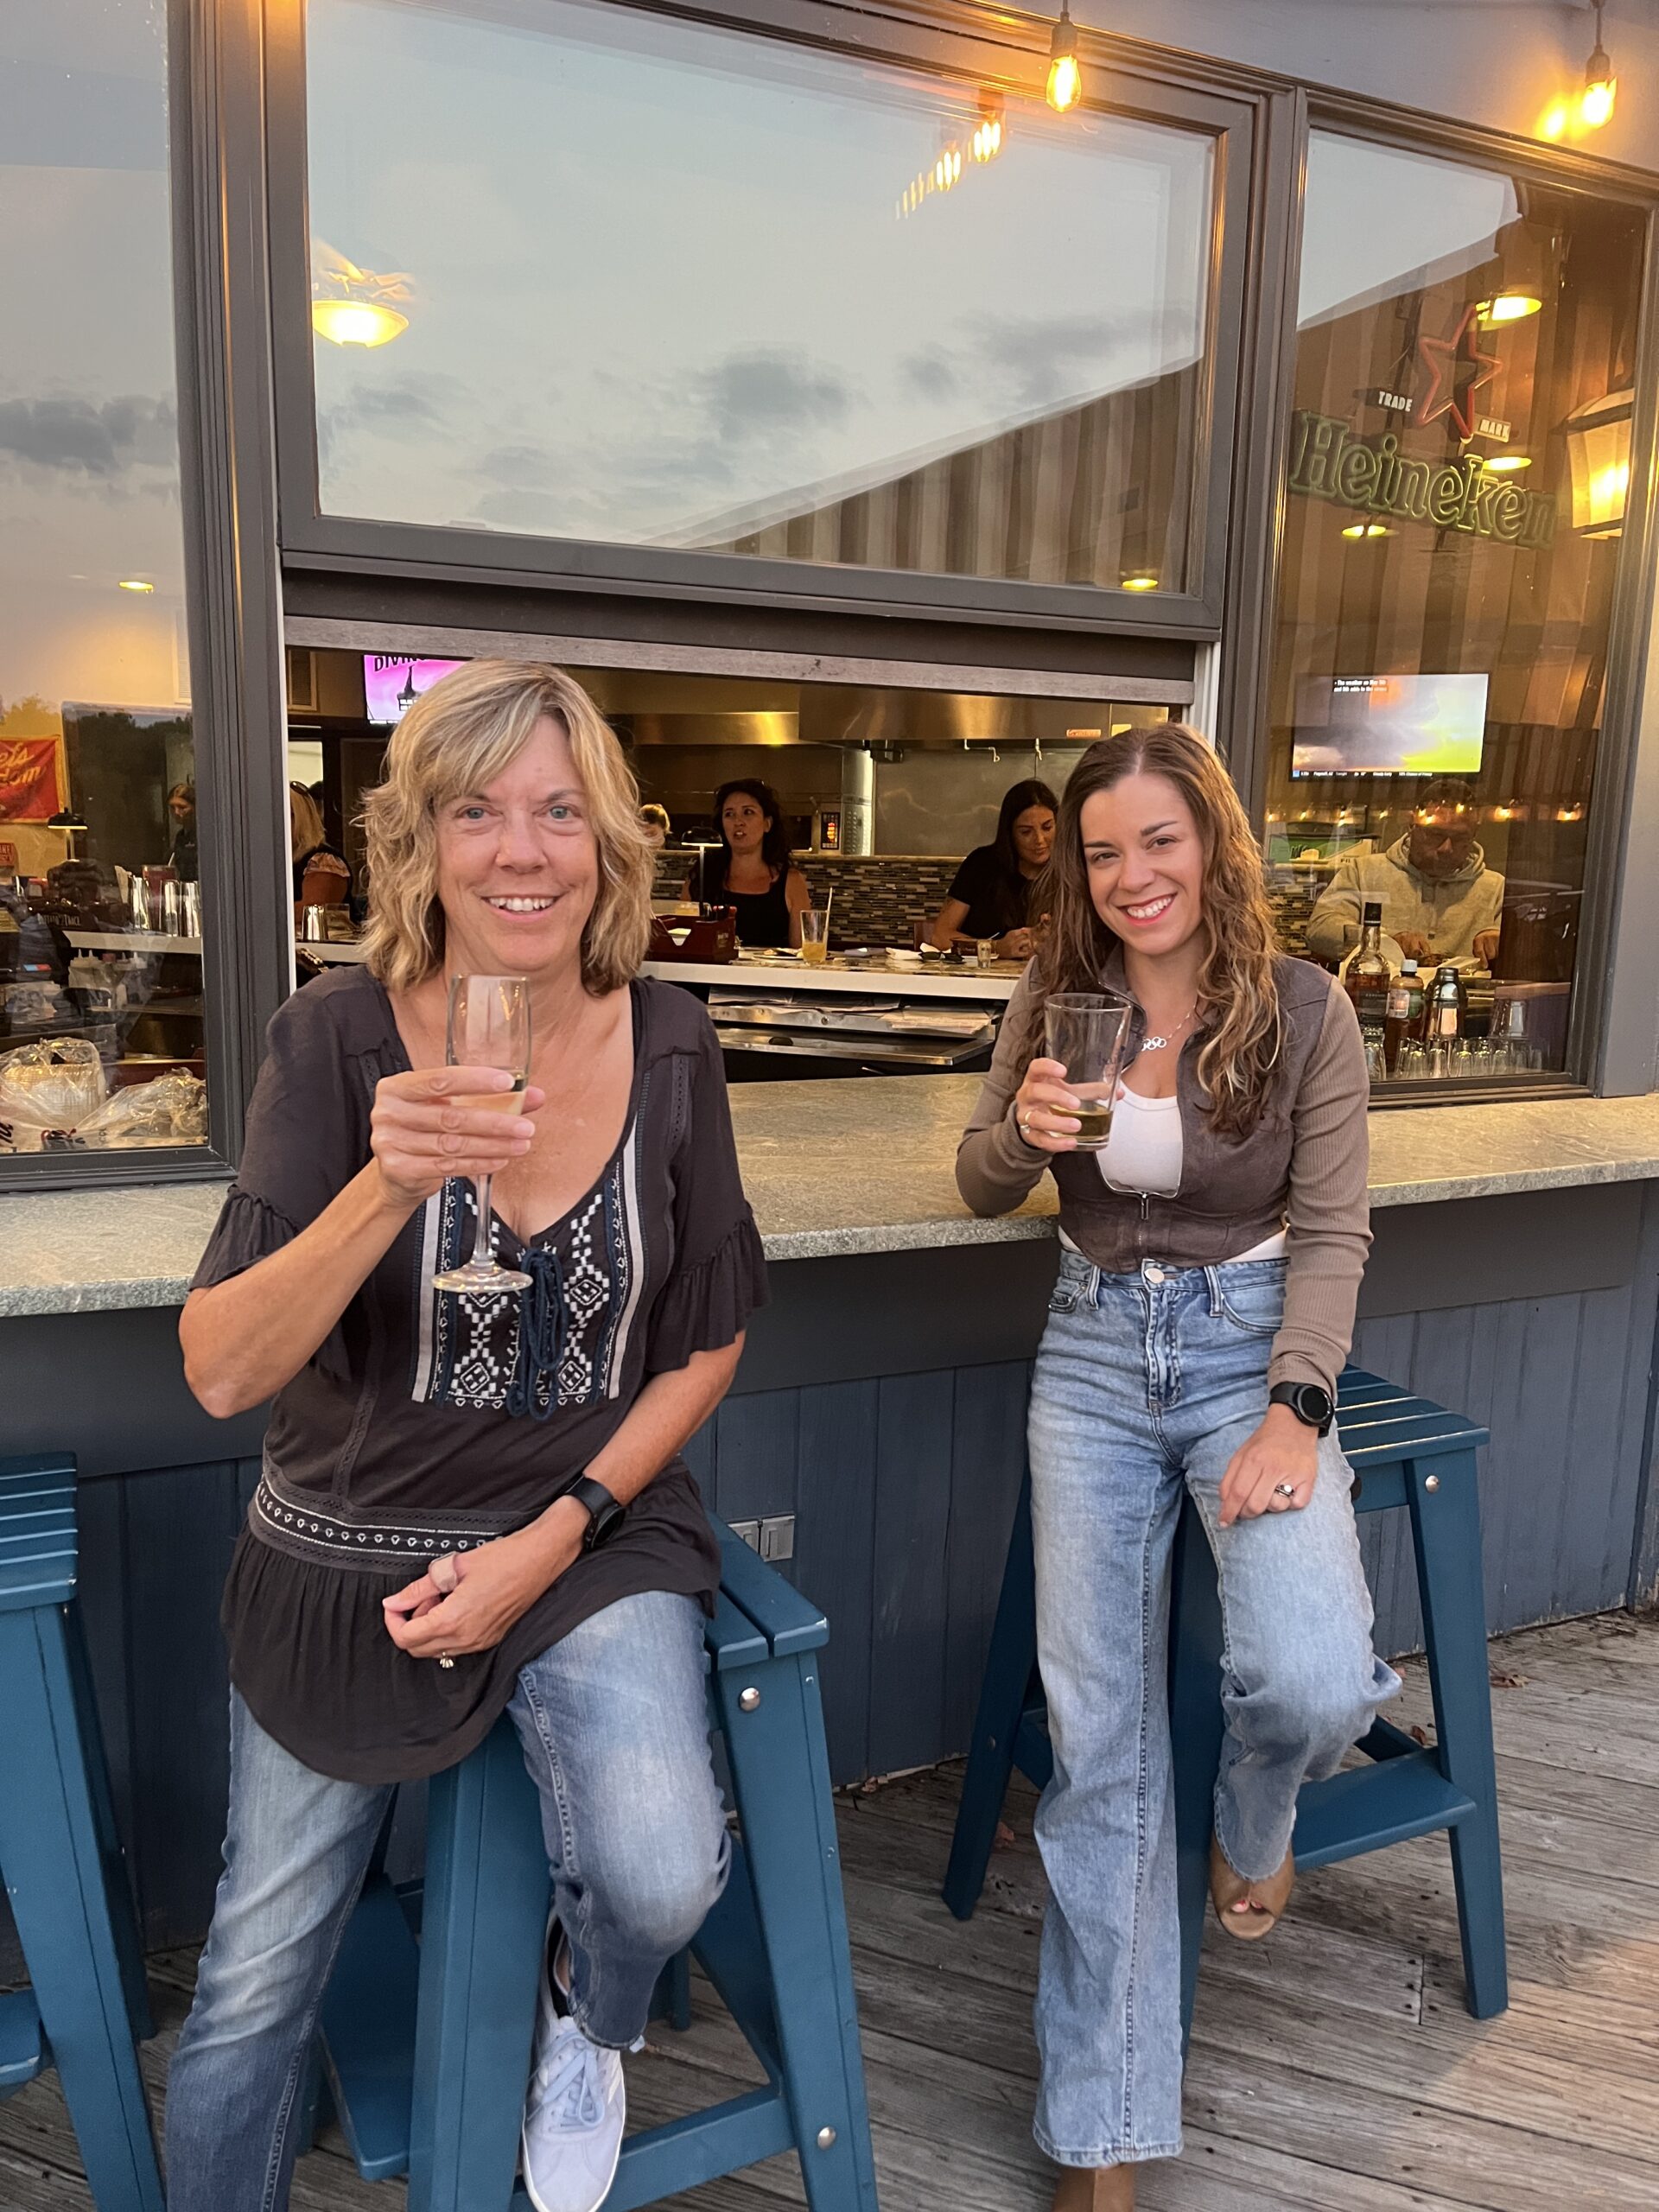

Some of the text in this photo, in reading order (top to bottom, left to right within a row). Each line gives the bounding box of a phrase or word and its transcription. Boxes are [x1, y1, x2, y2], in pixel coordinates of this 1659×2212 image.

[1378, 391, 1511, 441] TRADE MARK
[1288, 409, 1558, 550] Heineken
